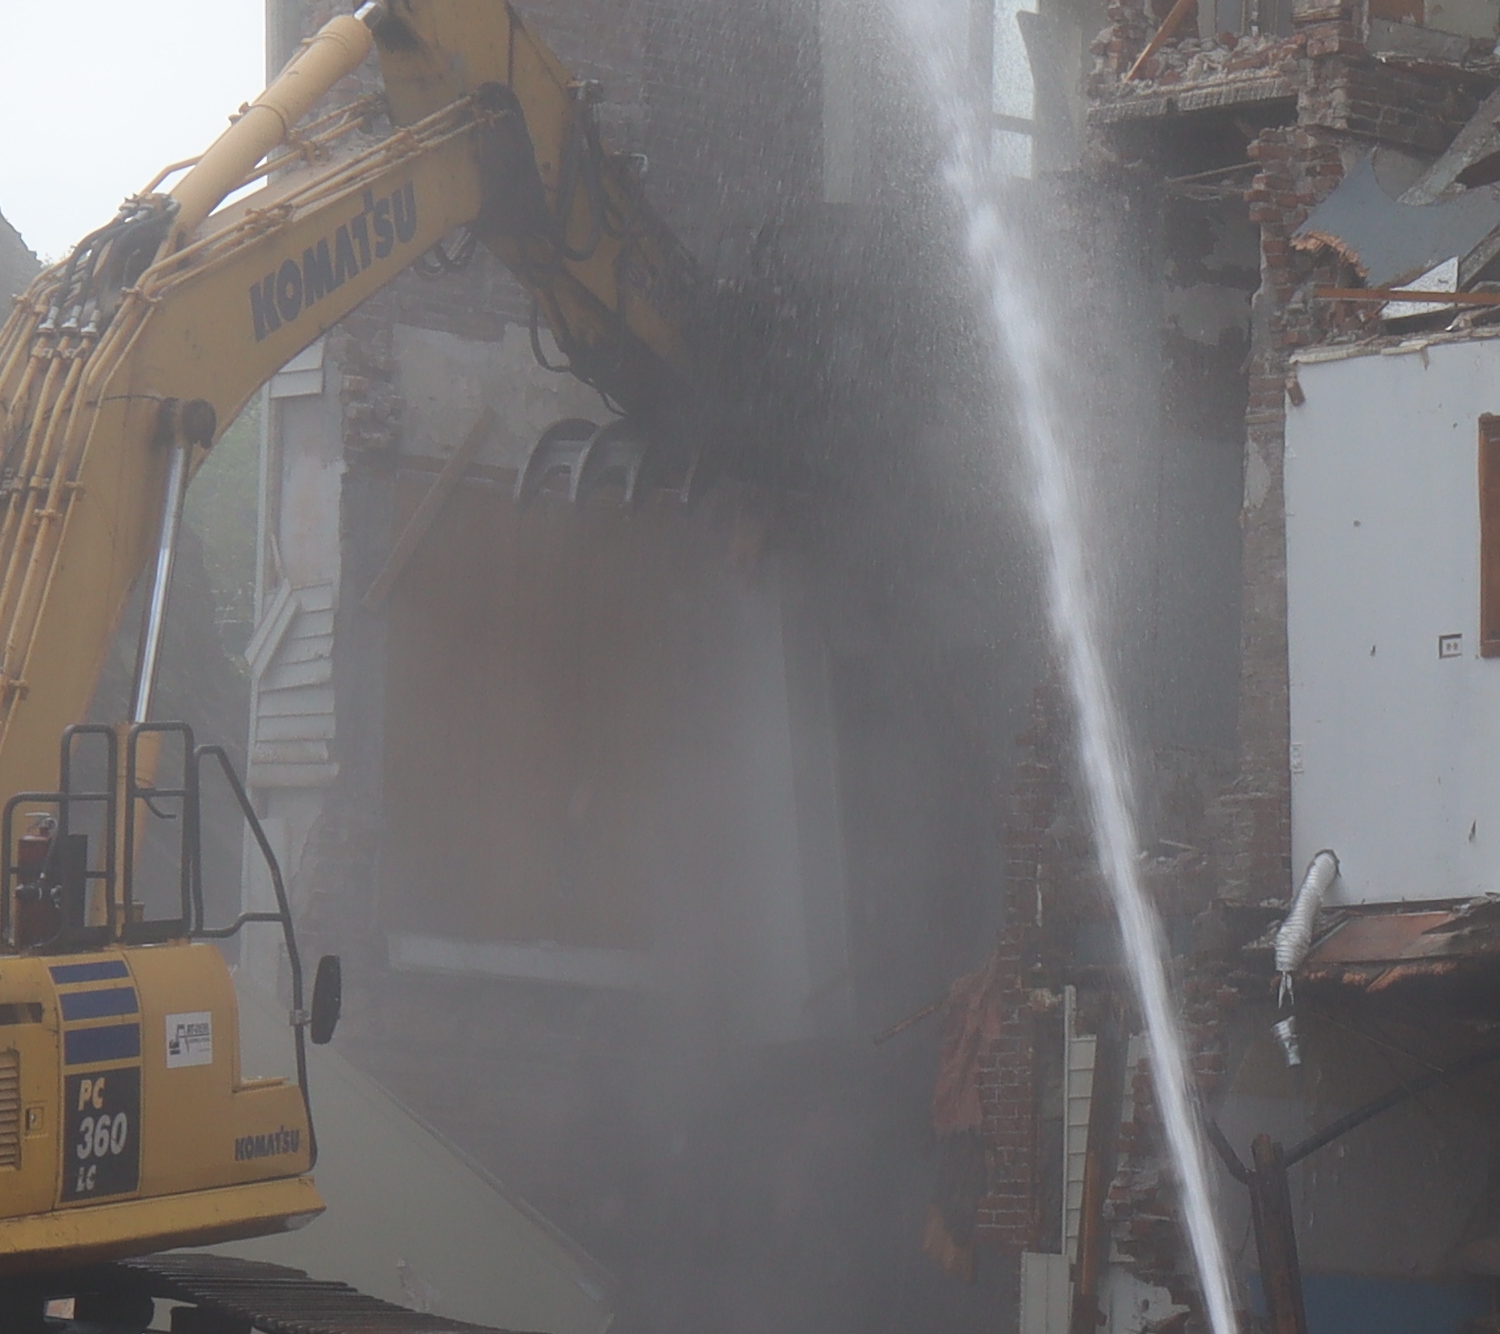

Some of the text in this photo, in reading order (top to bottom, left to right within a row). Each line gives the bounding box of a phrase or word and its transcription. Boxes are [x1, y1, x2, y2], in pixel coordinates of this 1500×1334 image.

[249, 181, 417, 343] KOMATSU
[78, 1077, 106, 1111] PC
[76, 1112, 128, 1159] 360
[235, 1125, 300, 1162] KOMATSU
[75, 1164, 97, 1192] LC
